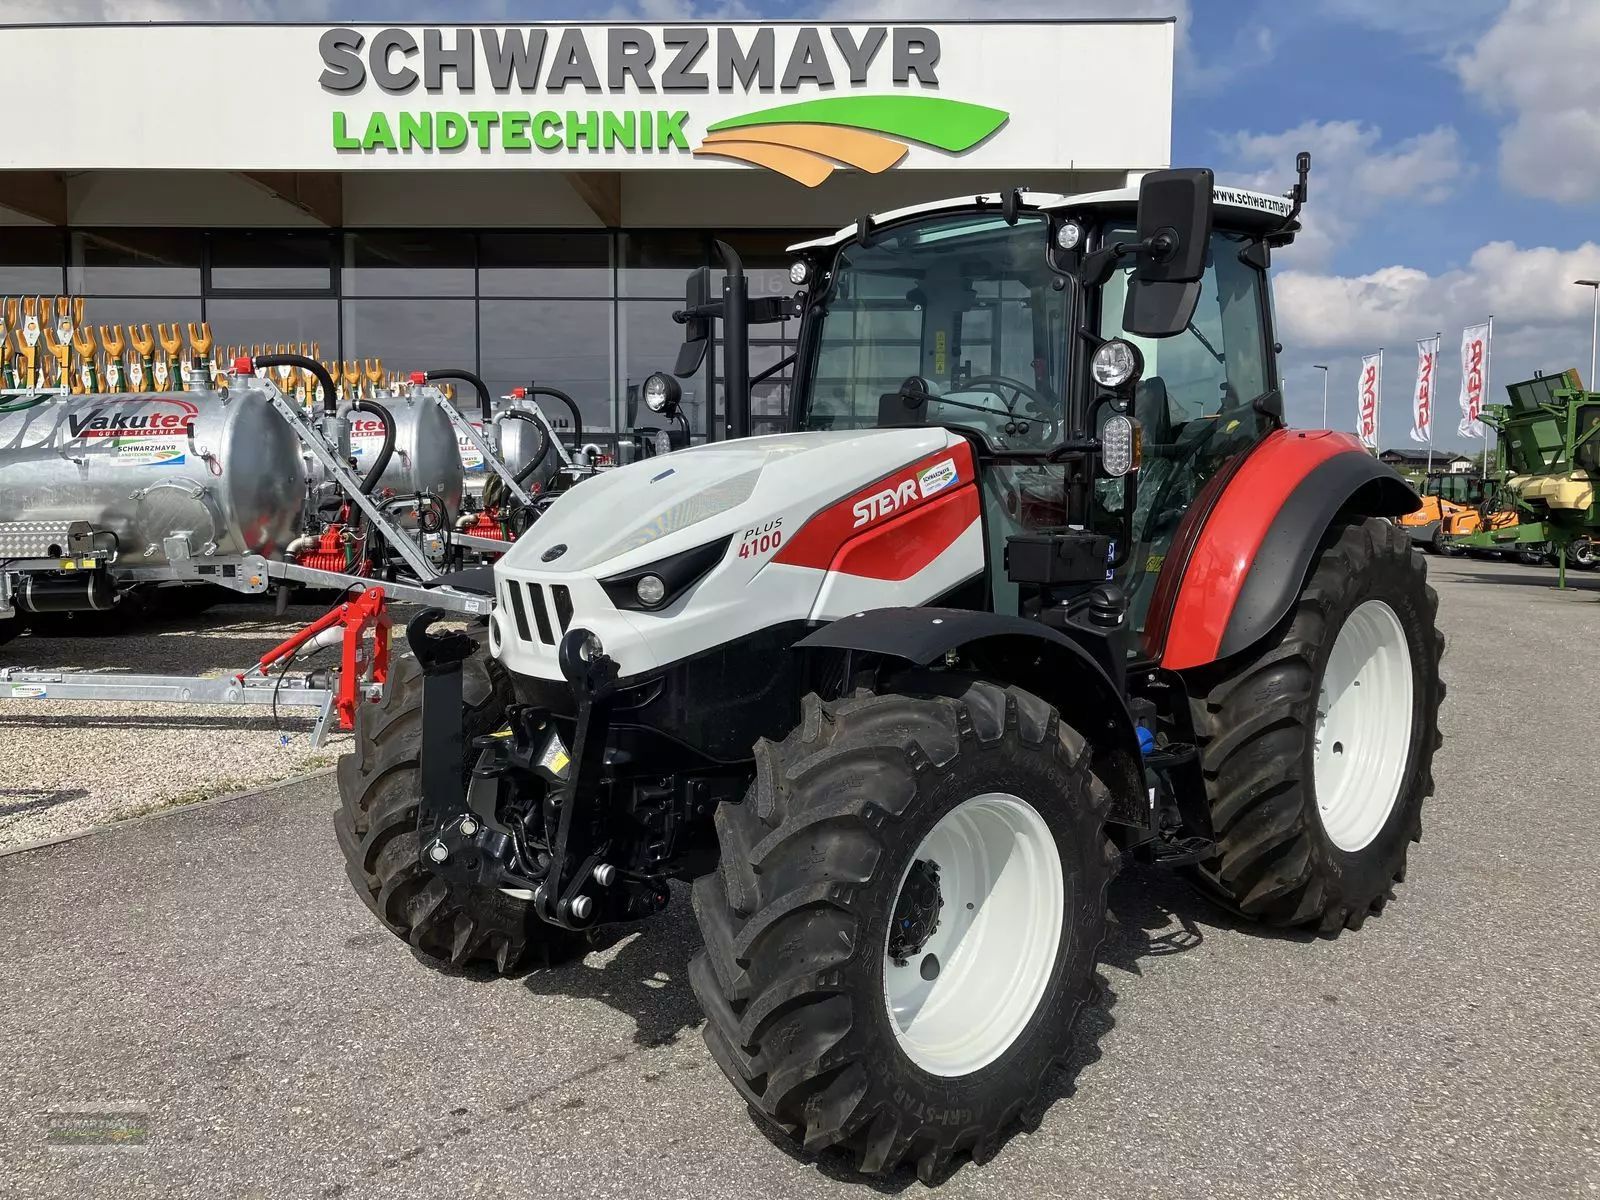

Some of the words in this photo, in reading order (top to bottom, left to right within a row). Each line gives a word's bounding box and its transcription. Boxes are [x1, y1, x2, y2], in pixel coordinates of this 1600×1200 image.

[318, 27, 941, 91] SCHWARZMAYR
[332, 110, 690, 149] LANDTECHNIK
[68, 408, 197, 438] Vakutec
[117, 444, 176, 453] SCHWARZMAYR
[853, 478, 919, 529] STEYR
[743, 516, 783, 541] PLUS
[738, 530, 782, 560] 4100
